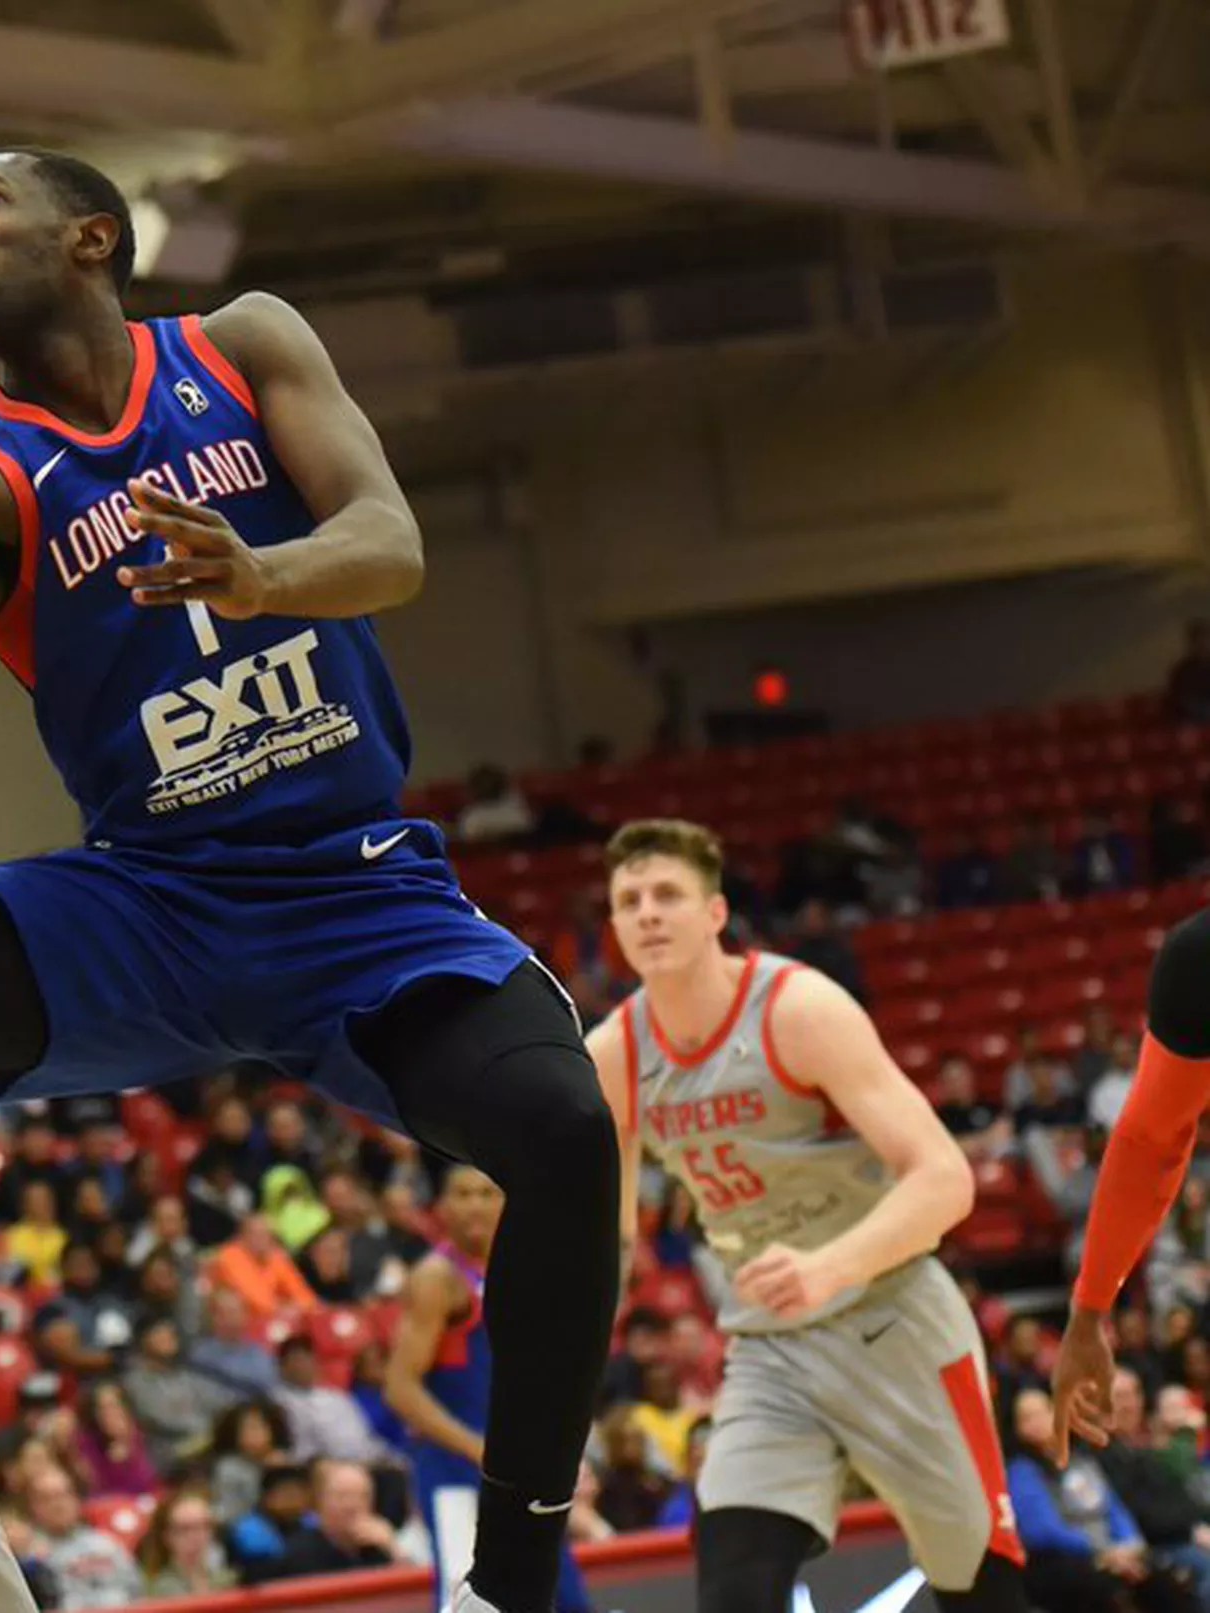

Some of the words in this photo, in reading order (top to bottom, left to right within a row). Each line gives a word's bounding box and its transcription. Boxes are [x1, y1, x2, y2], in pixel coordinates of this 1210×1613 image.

[139, 438, 269, 505] LAND
[146, 798, 180, 814] EXIT
[181, 774, 237, 806] REALTY
[237, 757, 269, 788] NEW
[269, 742, 312, 770] YORK
[645, 1088, 767, 1142] VIPERS
[682, 1140, 768, 1213] 55
